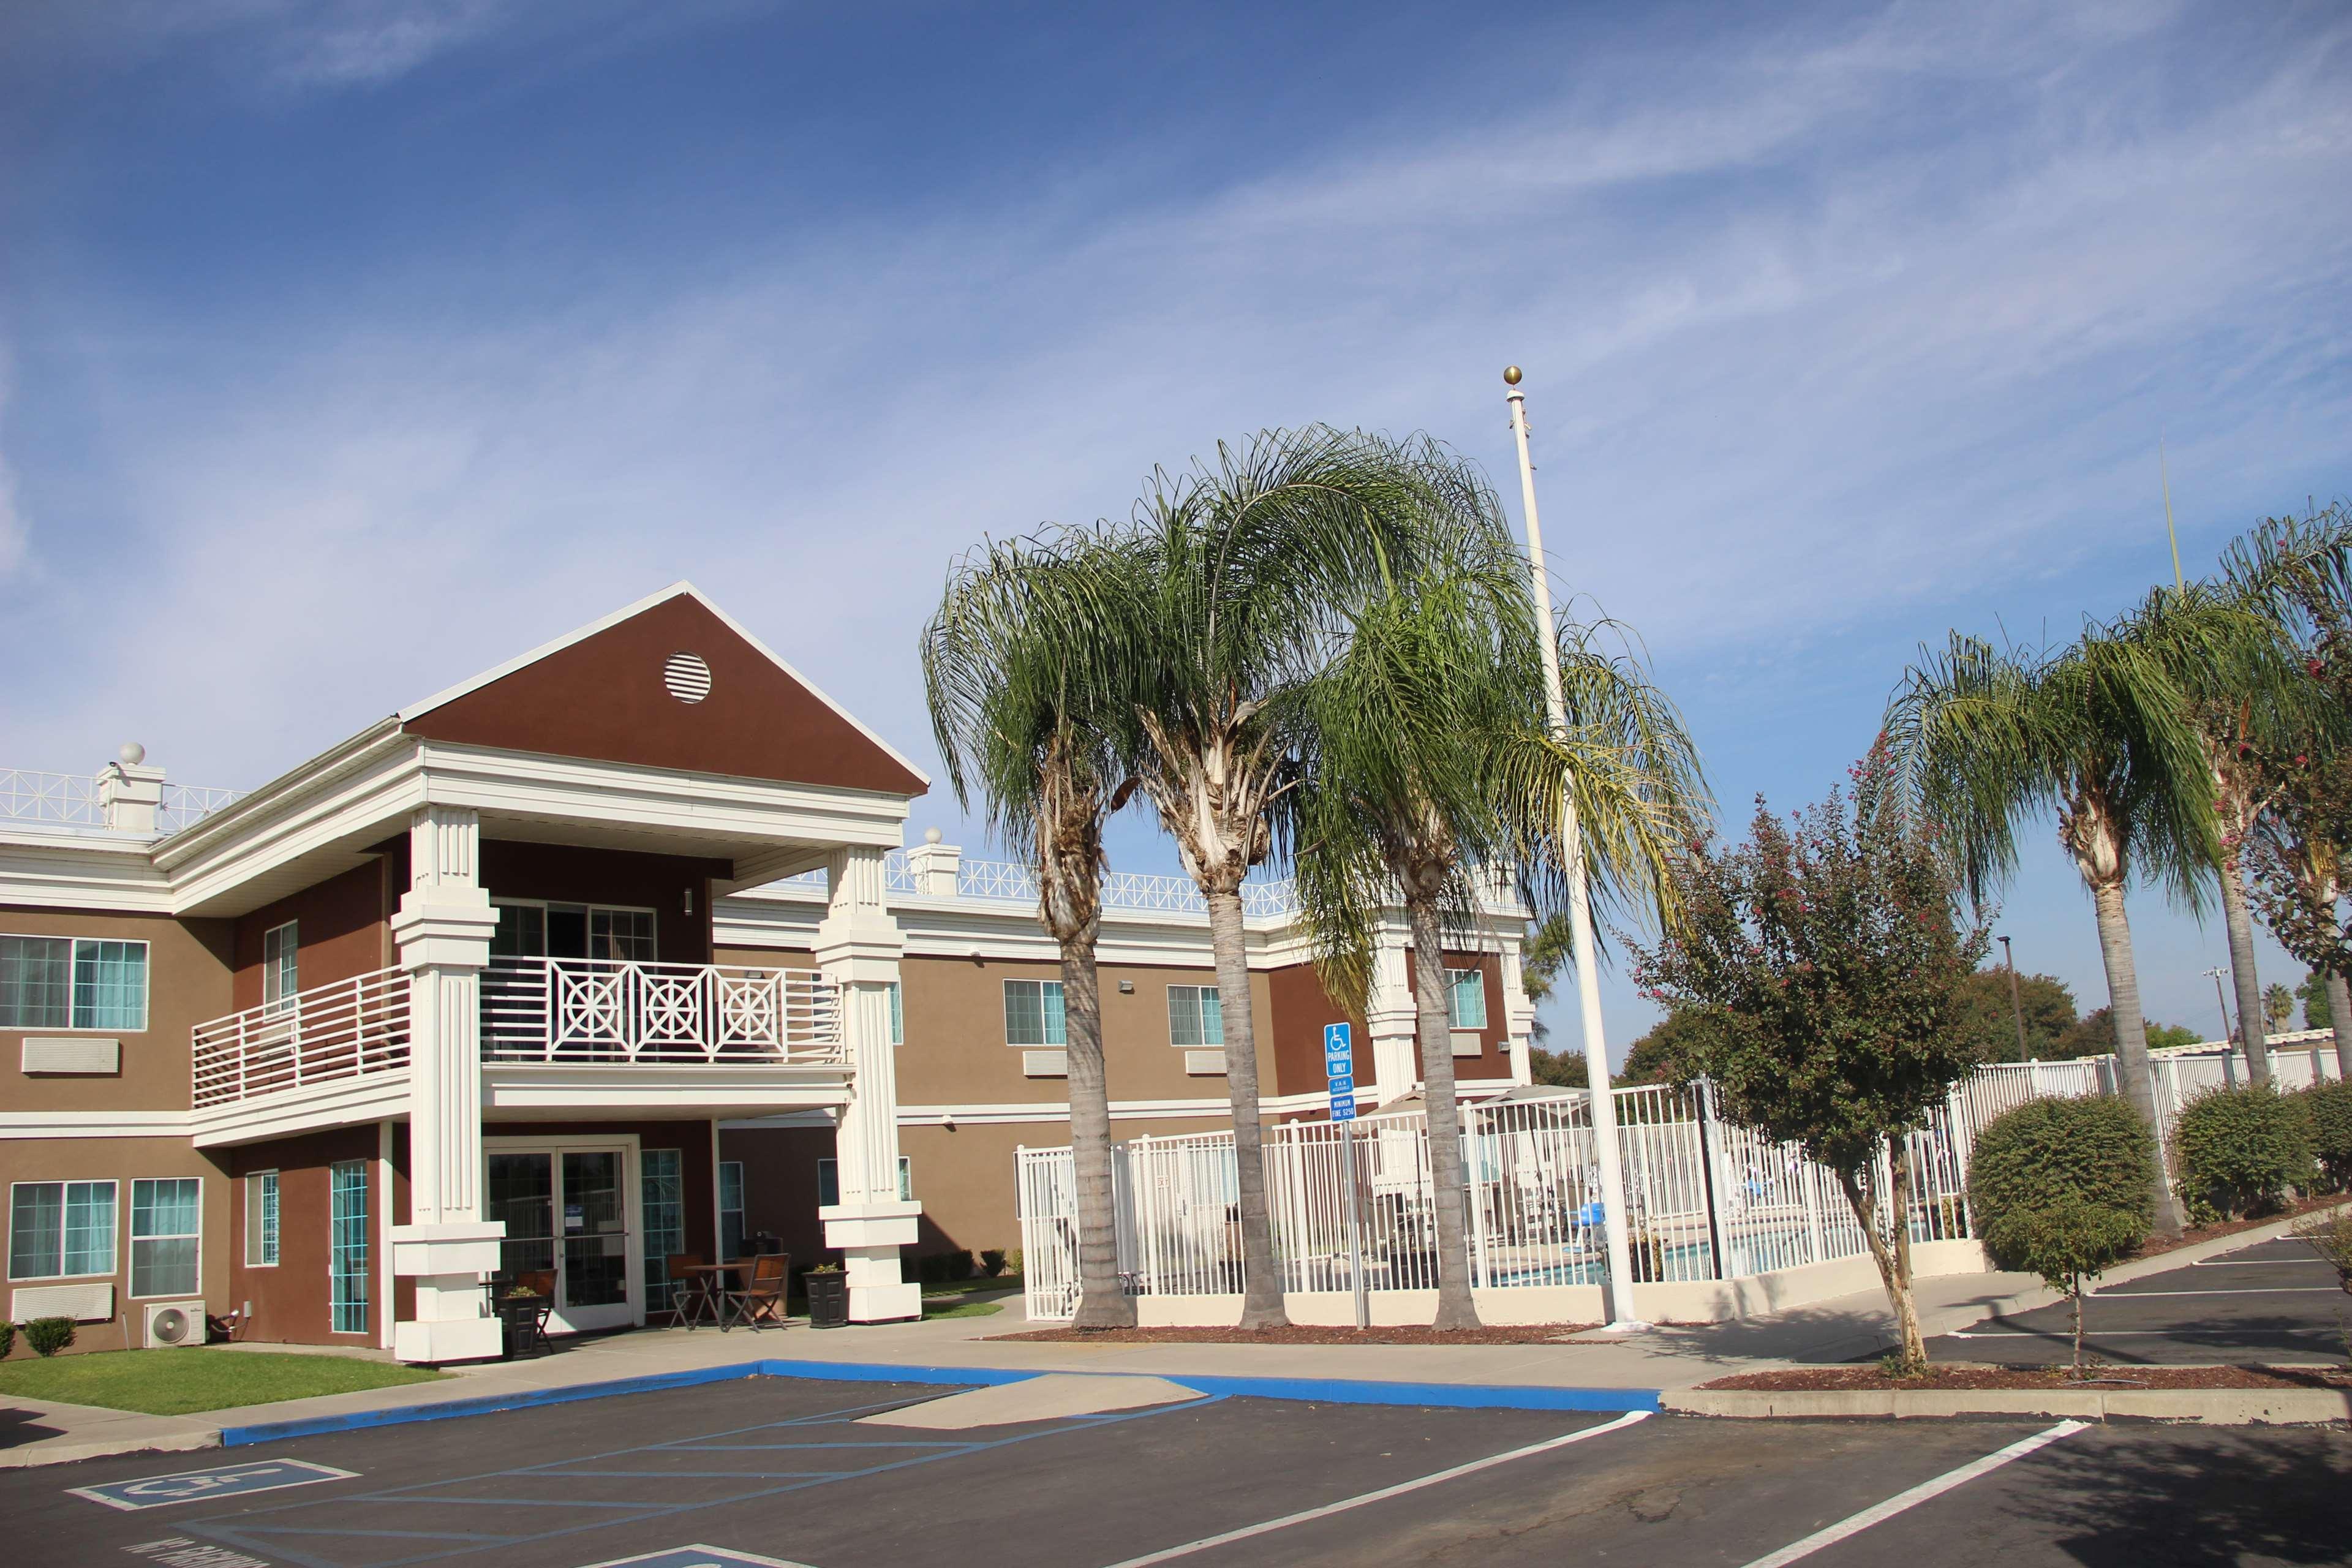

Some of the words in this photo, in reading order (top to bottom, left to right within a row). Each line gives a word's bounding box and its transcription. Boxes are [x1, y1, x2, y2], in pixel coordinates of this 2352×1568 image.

[1328, 1050, 1349, 1062] PARKING
[1333, 1063, 1346, 1073] ONLY
[1334, 1099, 1351, 1108] MINIMUM
[119, 1537, 196, 1553] NO
